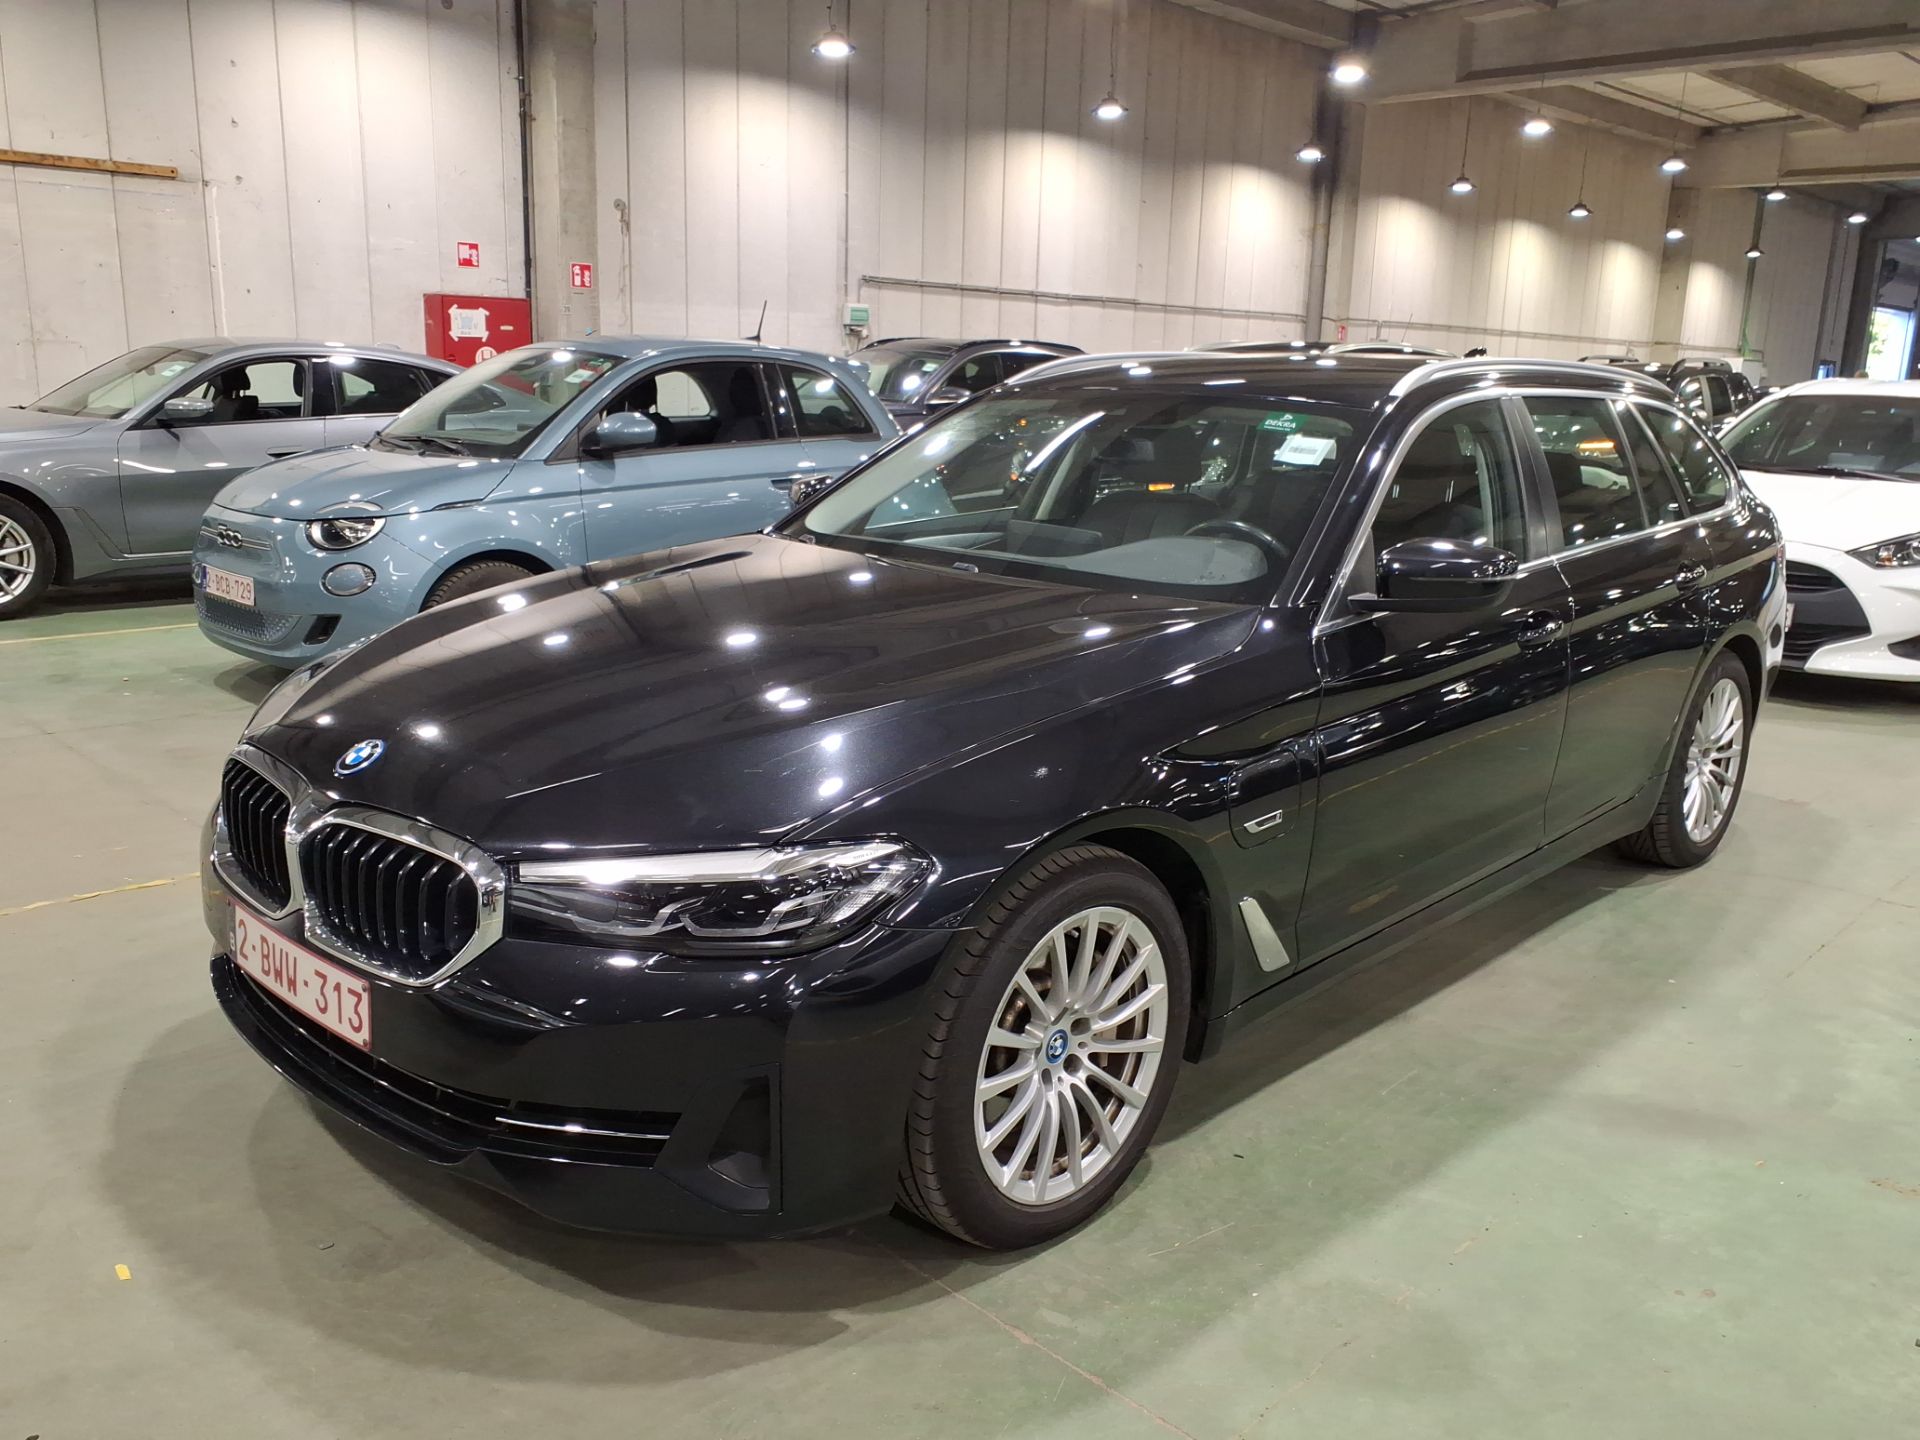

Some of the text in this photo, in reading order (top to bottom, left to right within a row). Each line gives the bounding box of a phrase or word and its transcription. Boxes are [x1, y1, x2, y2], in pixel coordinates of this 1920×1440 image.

[1264, 419, 1296, 429] DEKRA
[217, 524, 242, 547] 500
[238, 918, 363, 1034] 2-BWW-313
